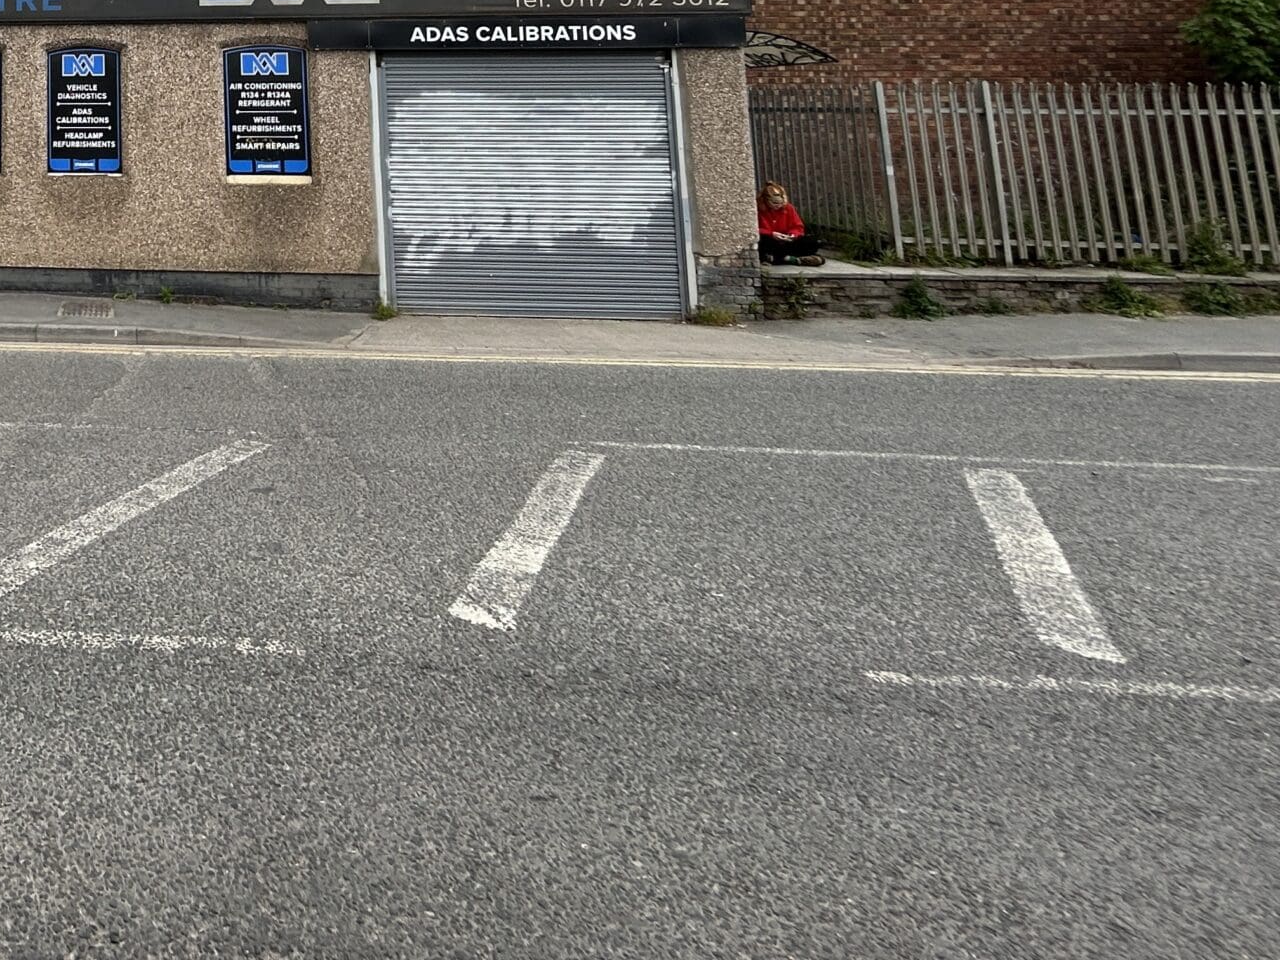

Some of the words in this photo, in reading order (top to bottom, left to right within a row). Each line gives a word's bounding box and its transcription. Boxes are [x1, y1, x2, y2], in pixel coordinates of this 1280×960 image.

[410, 27, 469, 42] ADAS
[475, 25, 636, 42] CALIBRATIONS
[56, 116, 109, 124] CALIBRATIONS
